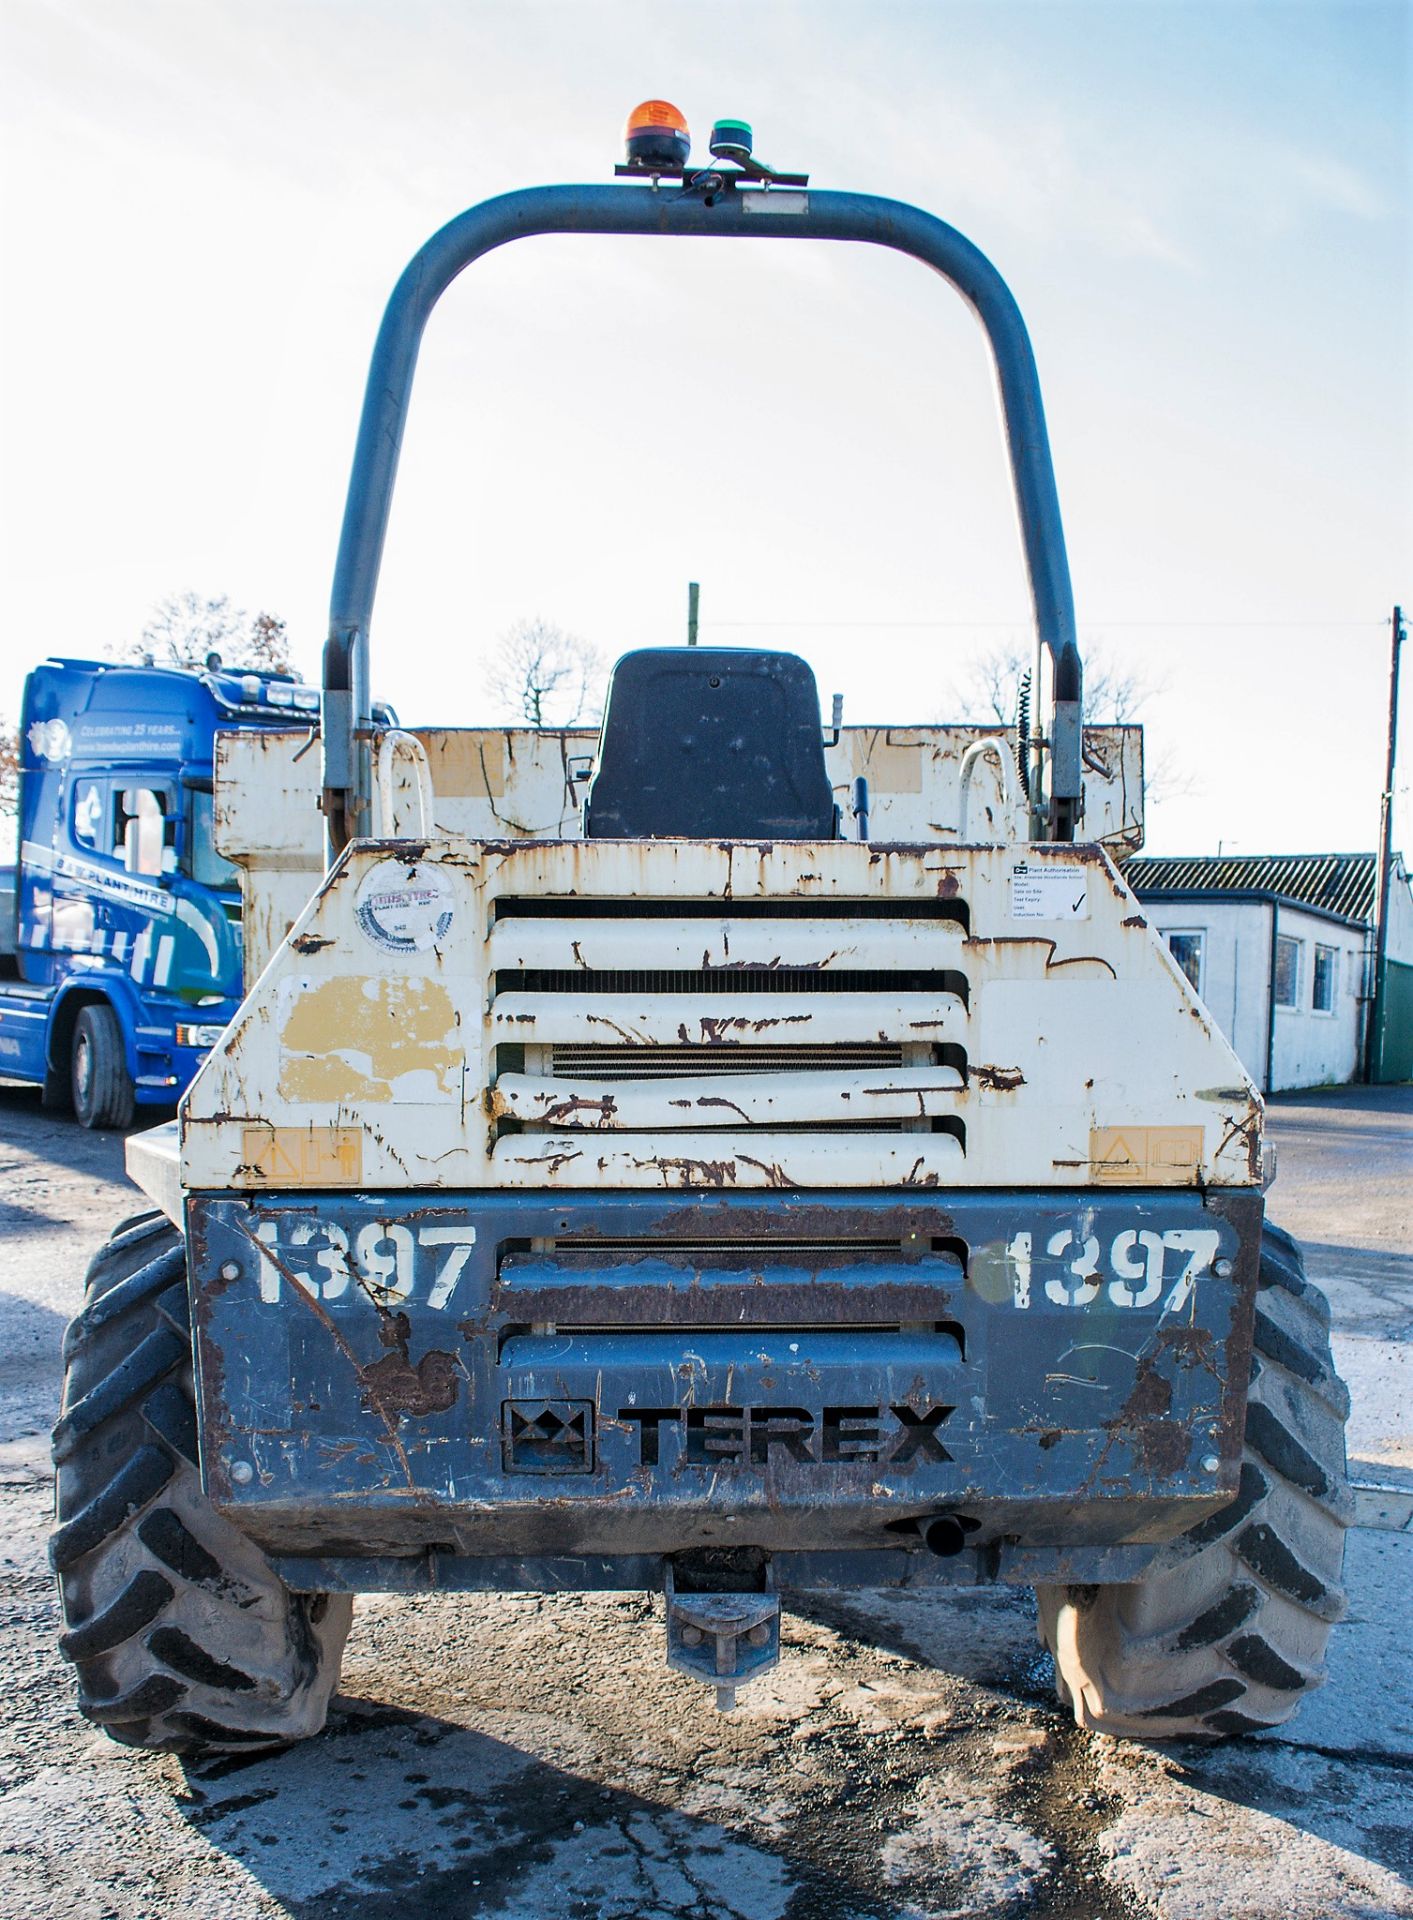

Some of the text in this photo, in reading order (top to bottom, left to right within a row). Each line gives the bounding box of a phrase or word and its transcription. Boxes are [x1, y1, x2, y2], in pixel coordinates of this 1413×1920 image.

[88, 871, 130, 891] PLANT
[134, 886, 170, 908] HIRE
[255, 1221, 477, 1311] 1397
[1006, 1229, 1220, 1312] 1397
[617, 1405, 957, 1466] TEREX
